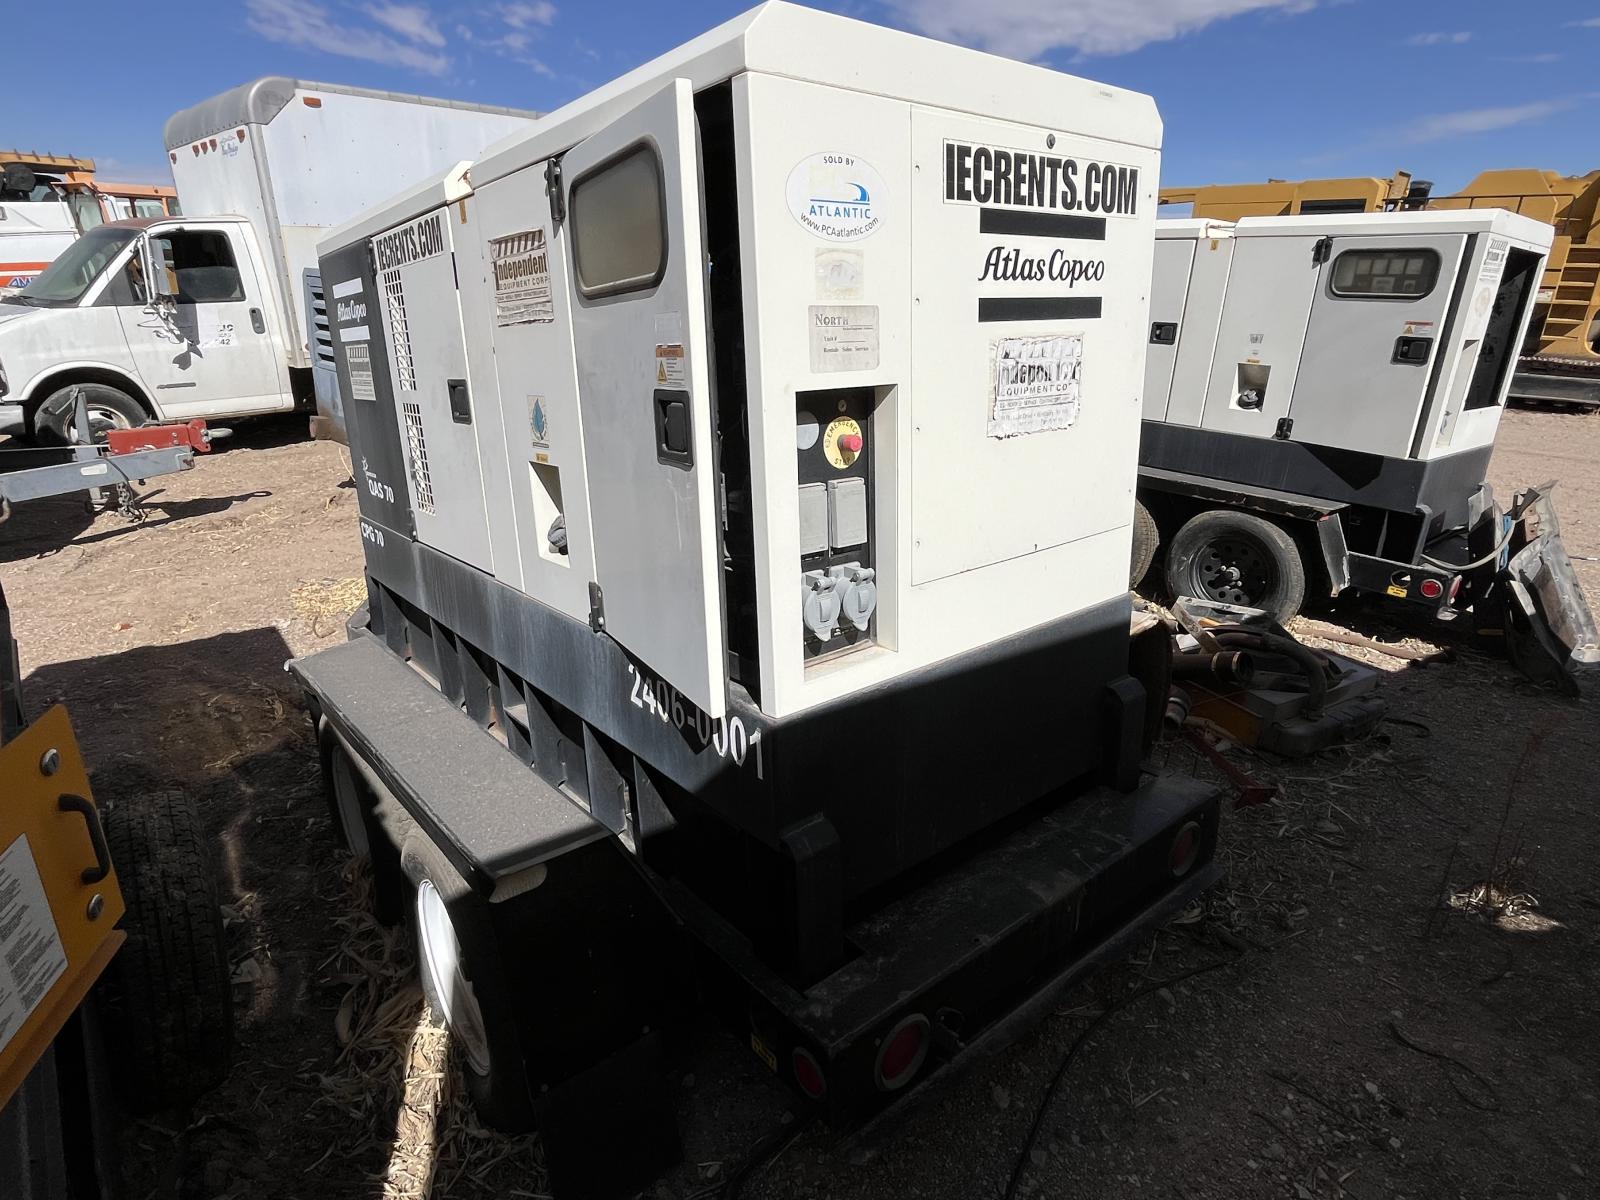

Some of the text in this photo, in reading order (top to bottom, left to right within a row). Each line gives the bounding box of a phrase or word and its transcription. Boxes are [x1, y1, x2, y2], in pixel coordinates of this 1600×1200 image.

[823, 155, 843, 164] SOLD
[945, 142, 1137, 215] IECRENTS.COM
[800, 212, 879, 238] www.PCAatlantic.com
[809, 204, 871, 219] ATLANTIC
[376, 215, 444, 271] IECRENTS.COM
[493, 252, 548, 291] Independent
[978, 246, 1105, 288] Atlas Copco
[368, 479, 395, 504] QAS 70
[374, 528, 385, 548] 70
[628, 663, 764, 781] 2406-0001
